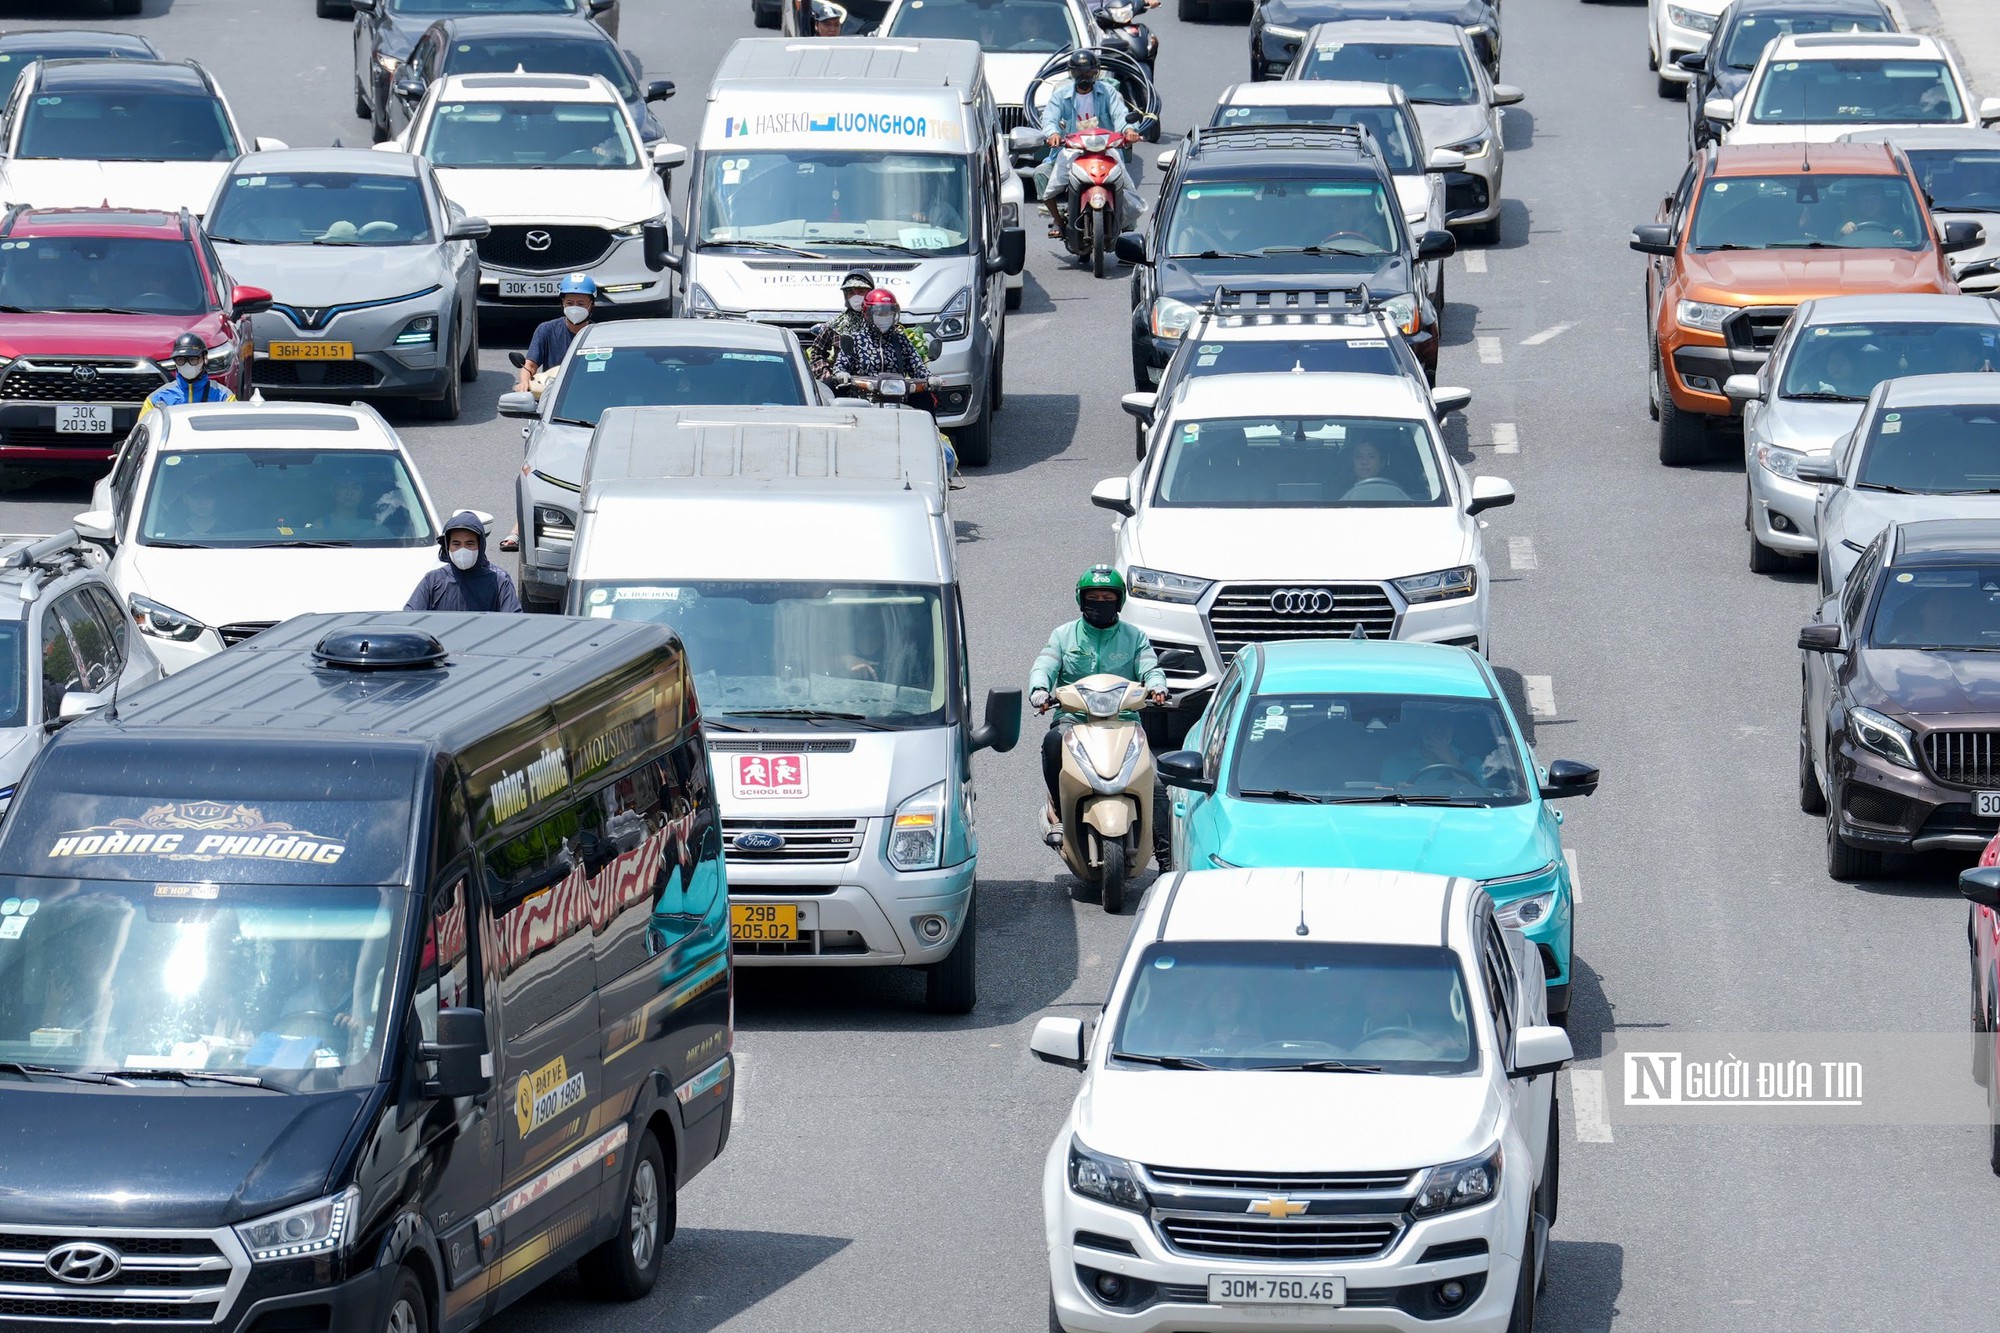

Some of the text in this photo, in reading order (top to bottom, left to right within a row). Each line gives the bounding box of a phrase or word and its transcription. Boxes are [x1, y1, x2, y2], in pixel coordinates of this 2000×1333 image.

[755, 112, 809, 135] HASEKO
[835, 112, 926, 137] LUONGHOA
[910, 237, 944, 248] BUS
[760, 275, 796, 285] THE
[800, 274, 902, 287] AUTHTIC
[276, 345, 345, 357] 36H-231.51
[72, 406, 96, 419] 30K
[62, 419, 107, 432] 203.98
[1092, 575, 1111, 583] Grab
[570, 721, 637, 780] LIMOUSINE
[188, 805, 221, 817] VIP
[744, 834, 773, 847] Ford
[48, 831, 346, 864] HOÀNG PHƯƠNG
[744, 906, 777, 922] 29B
[732, 923, 790, 939] 205.02
[535, 1075, 582, 1126] 1900 1988
[1220, 1279, 1334, 1300] 30M-760.46
